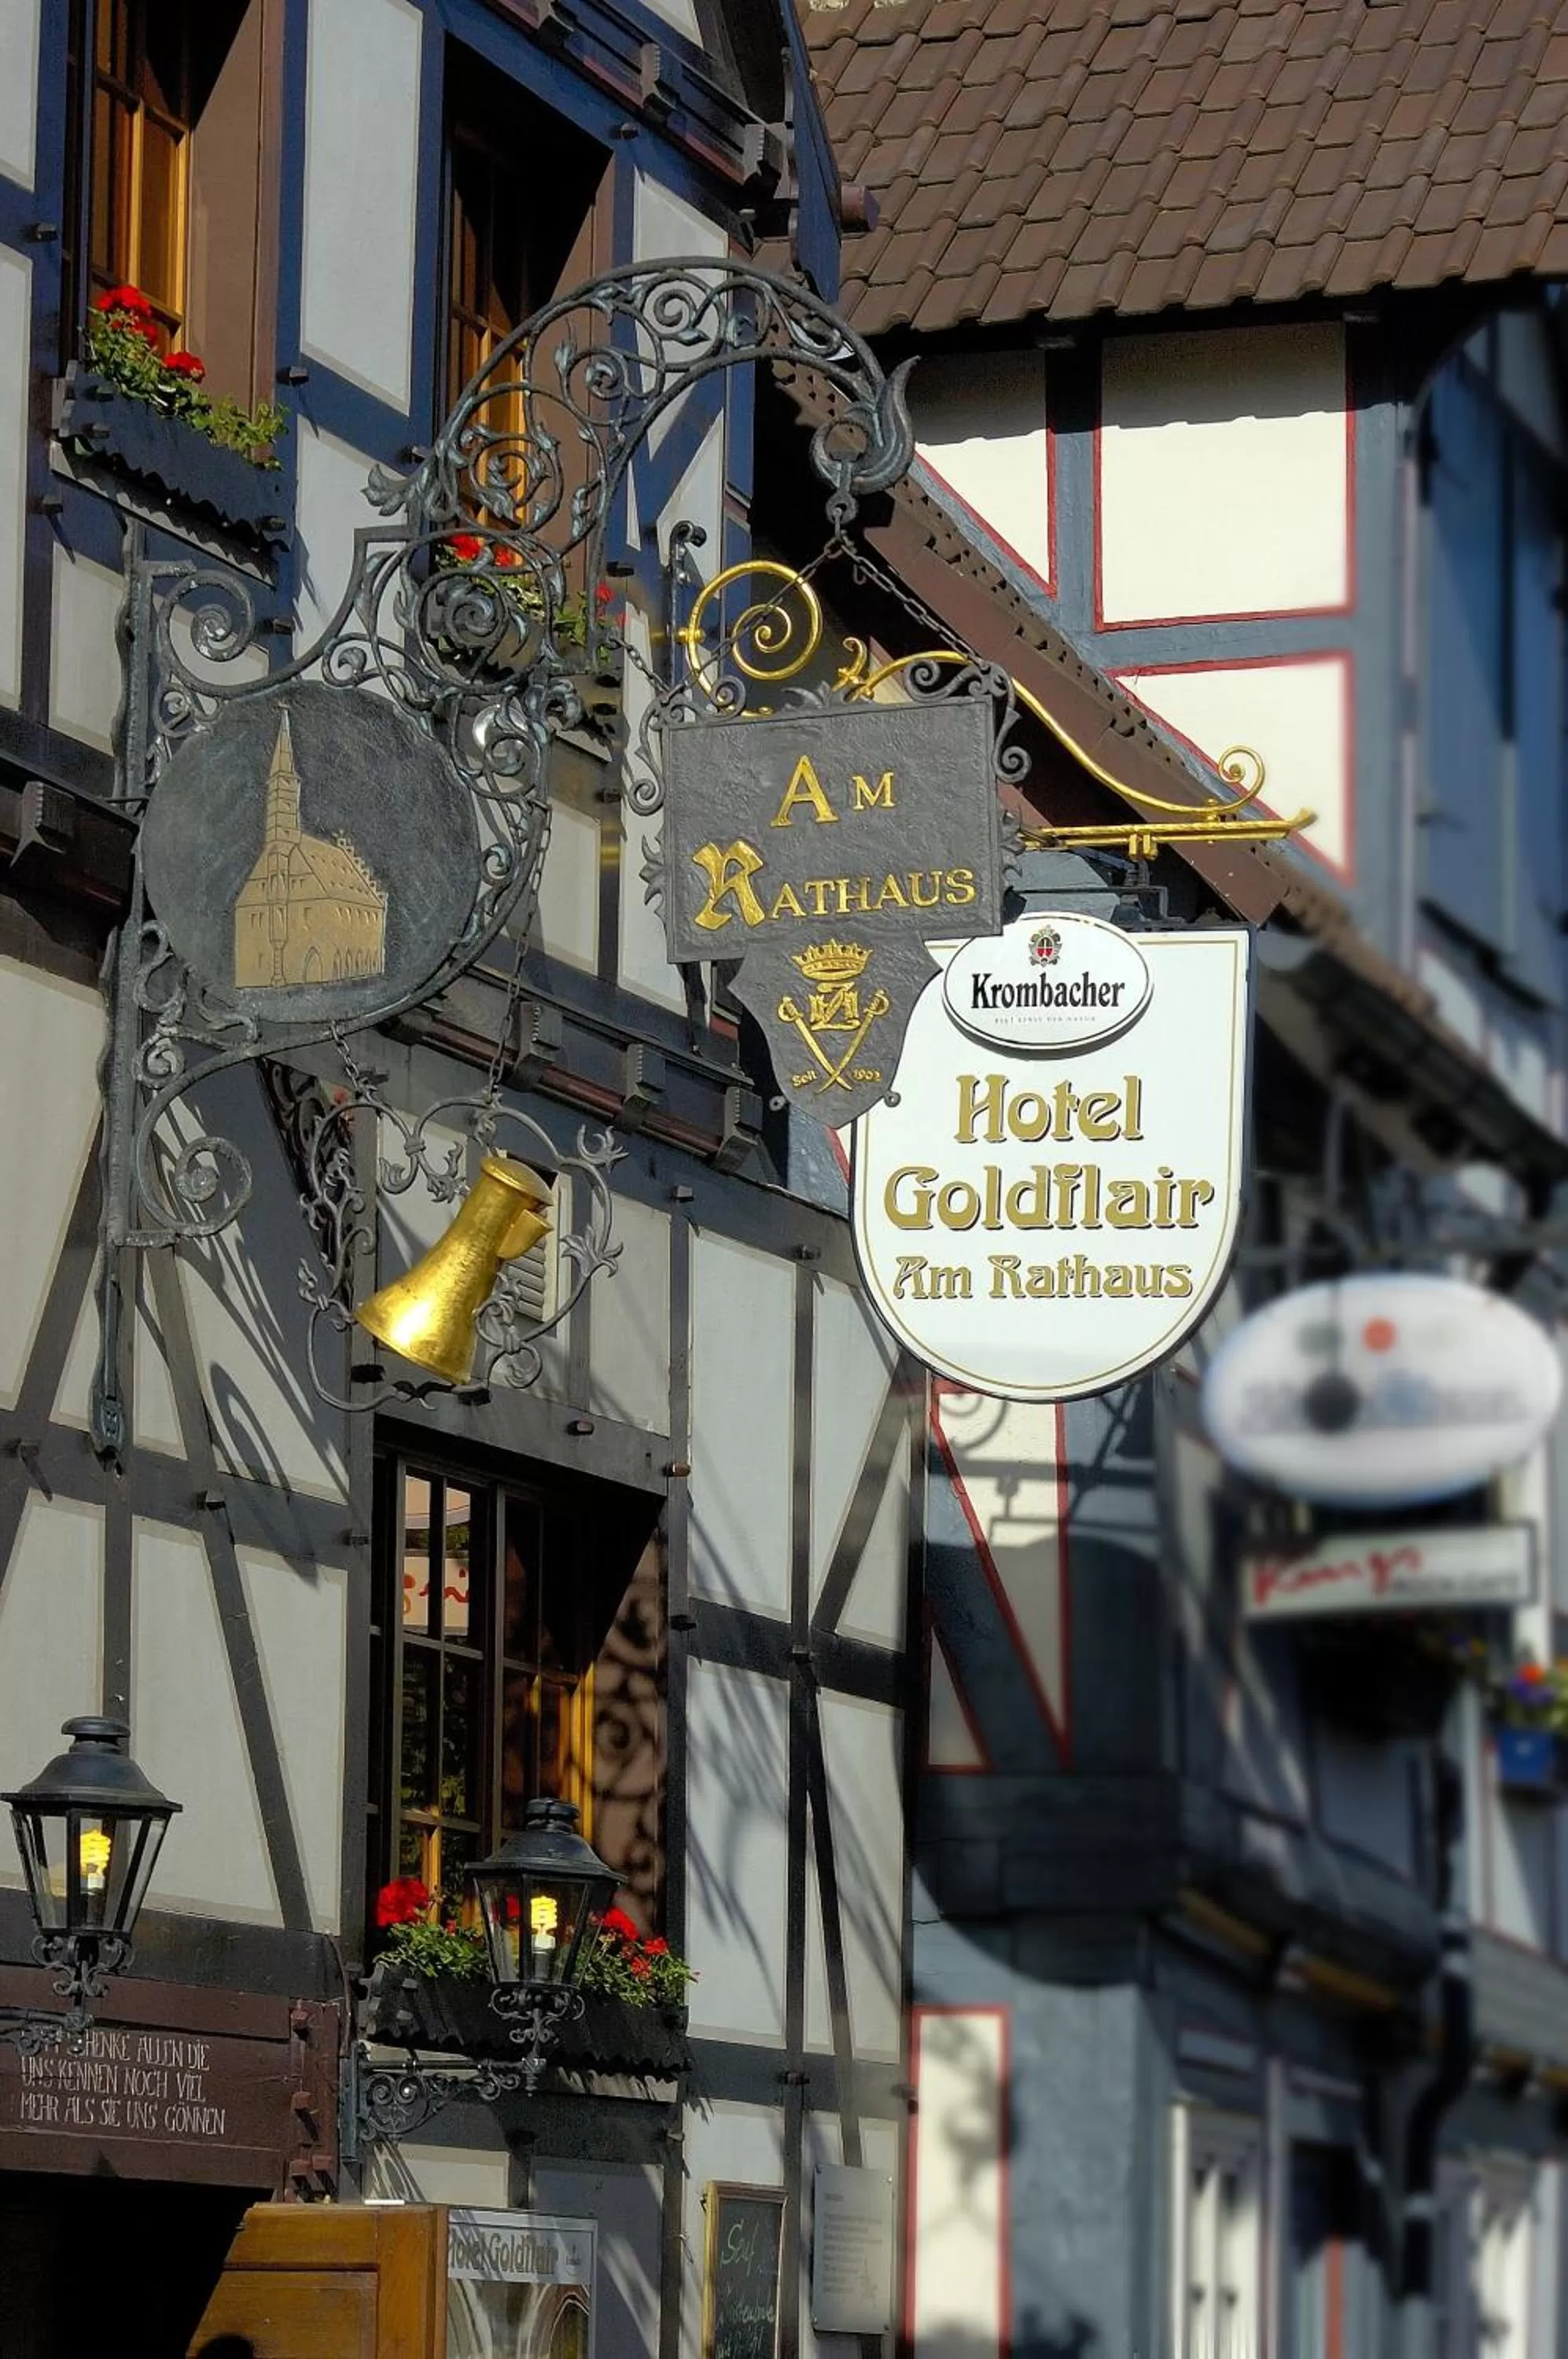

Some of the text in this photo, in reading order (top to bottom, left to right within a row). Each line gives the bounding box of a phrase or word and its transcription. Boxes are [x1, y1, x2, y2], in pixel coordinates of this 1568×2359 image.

[970, 971, 1125, 1009] Krombacher
[954, 1074, 1144, 1143] Hotel
[883, 1163, 1216, 1231] Goldflair
[892, 1254, 1194, 1300] Am Rathaus
[68, 2029, 131, 2061] HENKE
[137, 2035, 184, 2068] ALLEN
[20, 2056, 207, 2103] UNS KENNEN NOCH VIEL
[20, 2091, 226, 2135] MEHR ALS SIE UNS GÖNNEN
